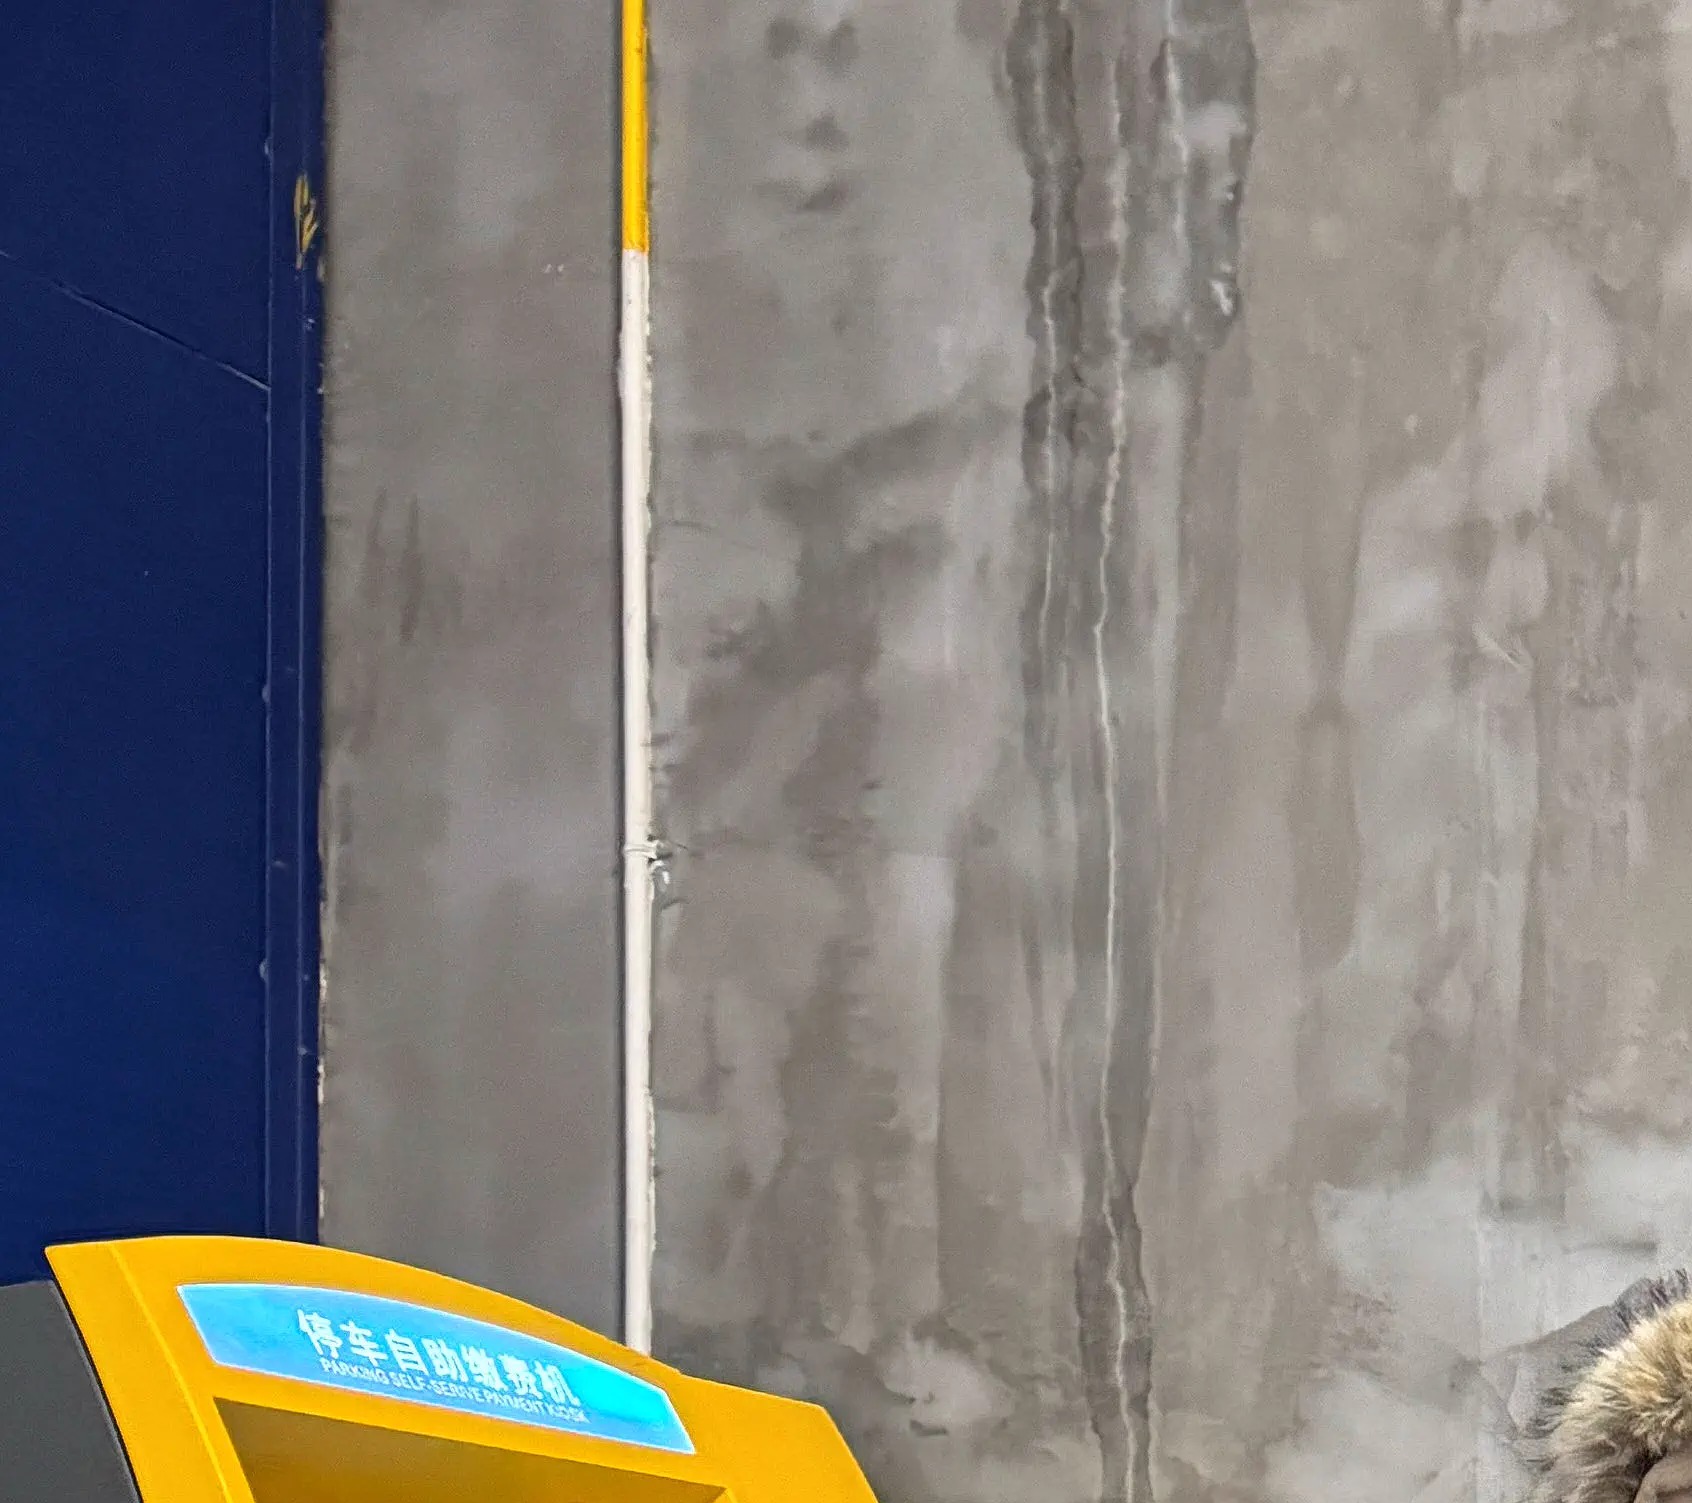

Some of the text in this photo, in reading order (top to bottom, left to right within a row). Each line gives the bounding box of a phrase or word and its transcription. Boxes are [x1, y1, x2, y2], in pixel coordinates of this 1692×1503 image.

[297, 1309, 581, 1407] 停车自助缴费机
[319, 1356, 390, 1385] PARKING
